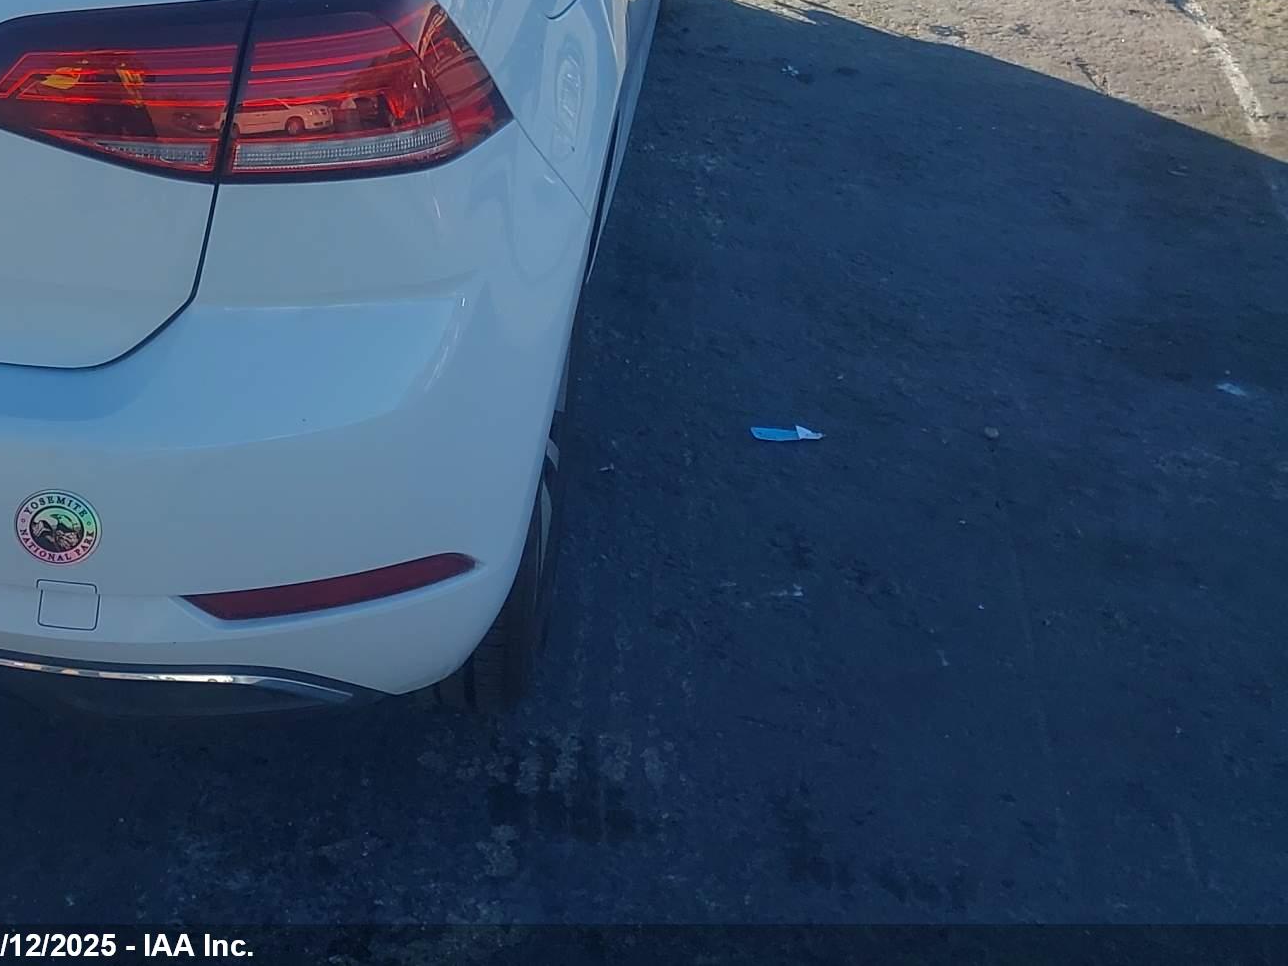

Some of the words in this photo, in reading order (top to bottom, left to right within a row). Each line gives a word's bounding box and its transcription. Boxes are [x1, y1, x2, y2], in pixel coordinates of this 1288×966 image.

[23, 495, 88, 518] YOSEMITE
[20, 528, 72, 562] NATIONAL
[73, 531, 95, 557] PARK
